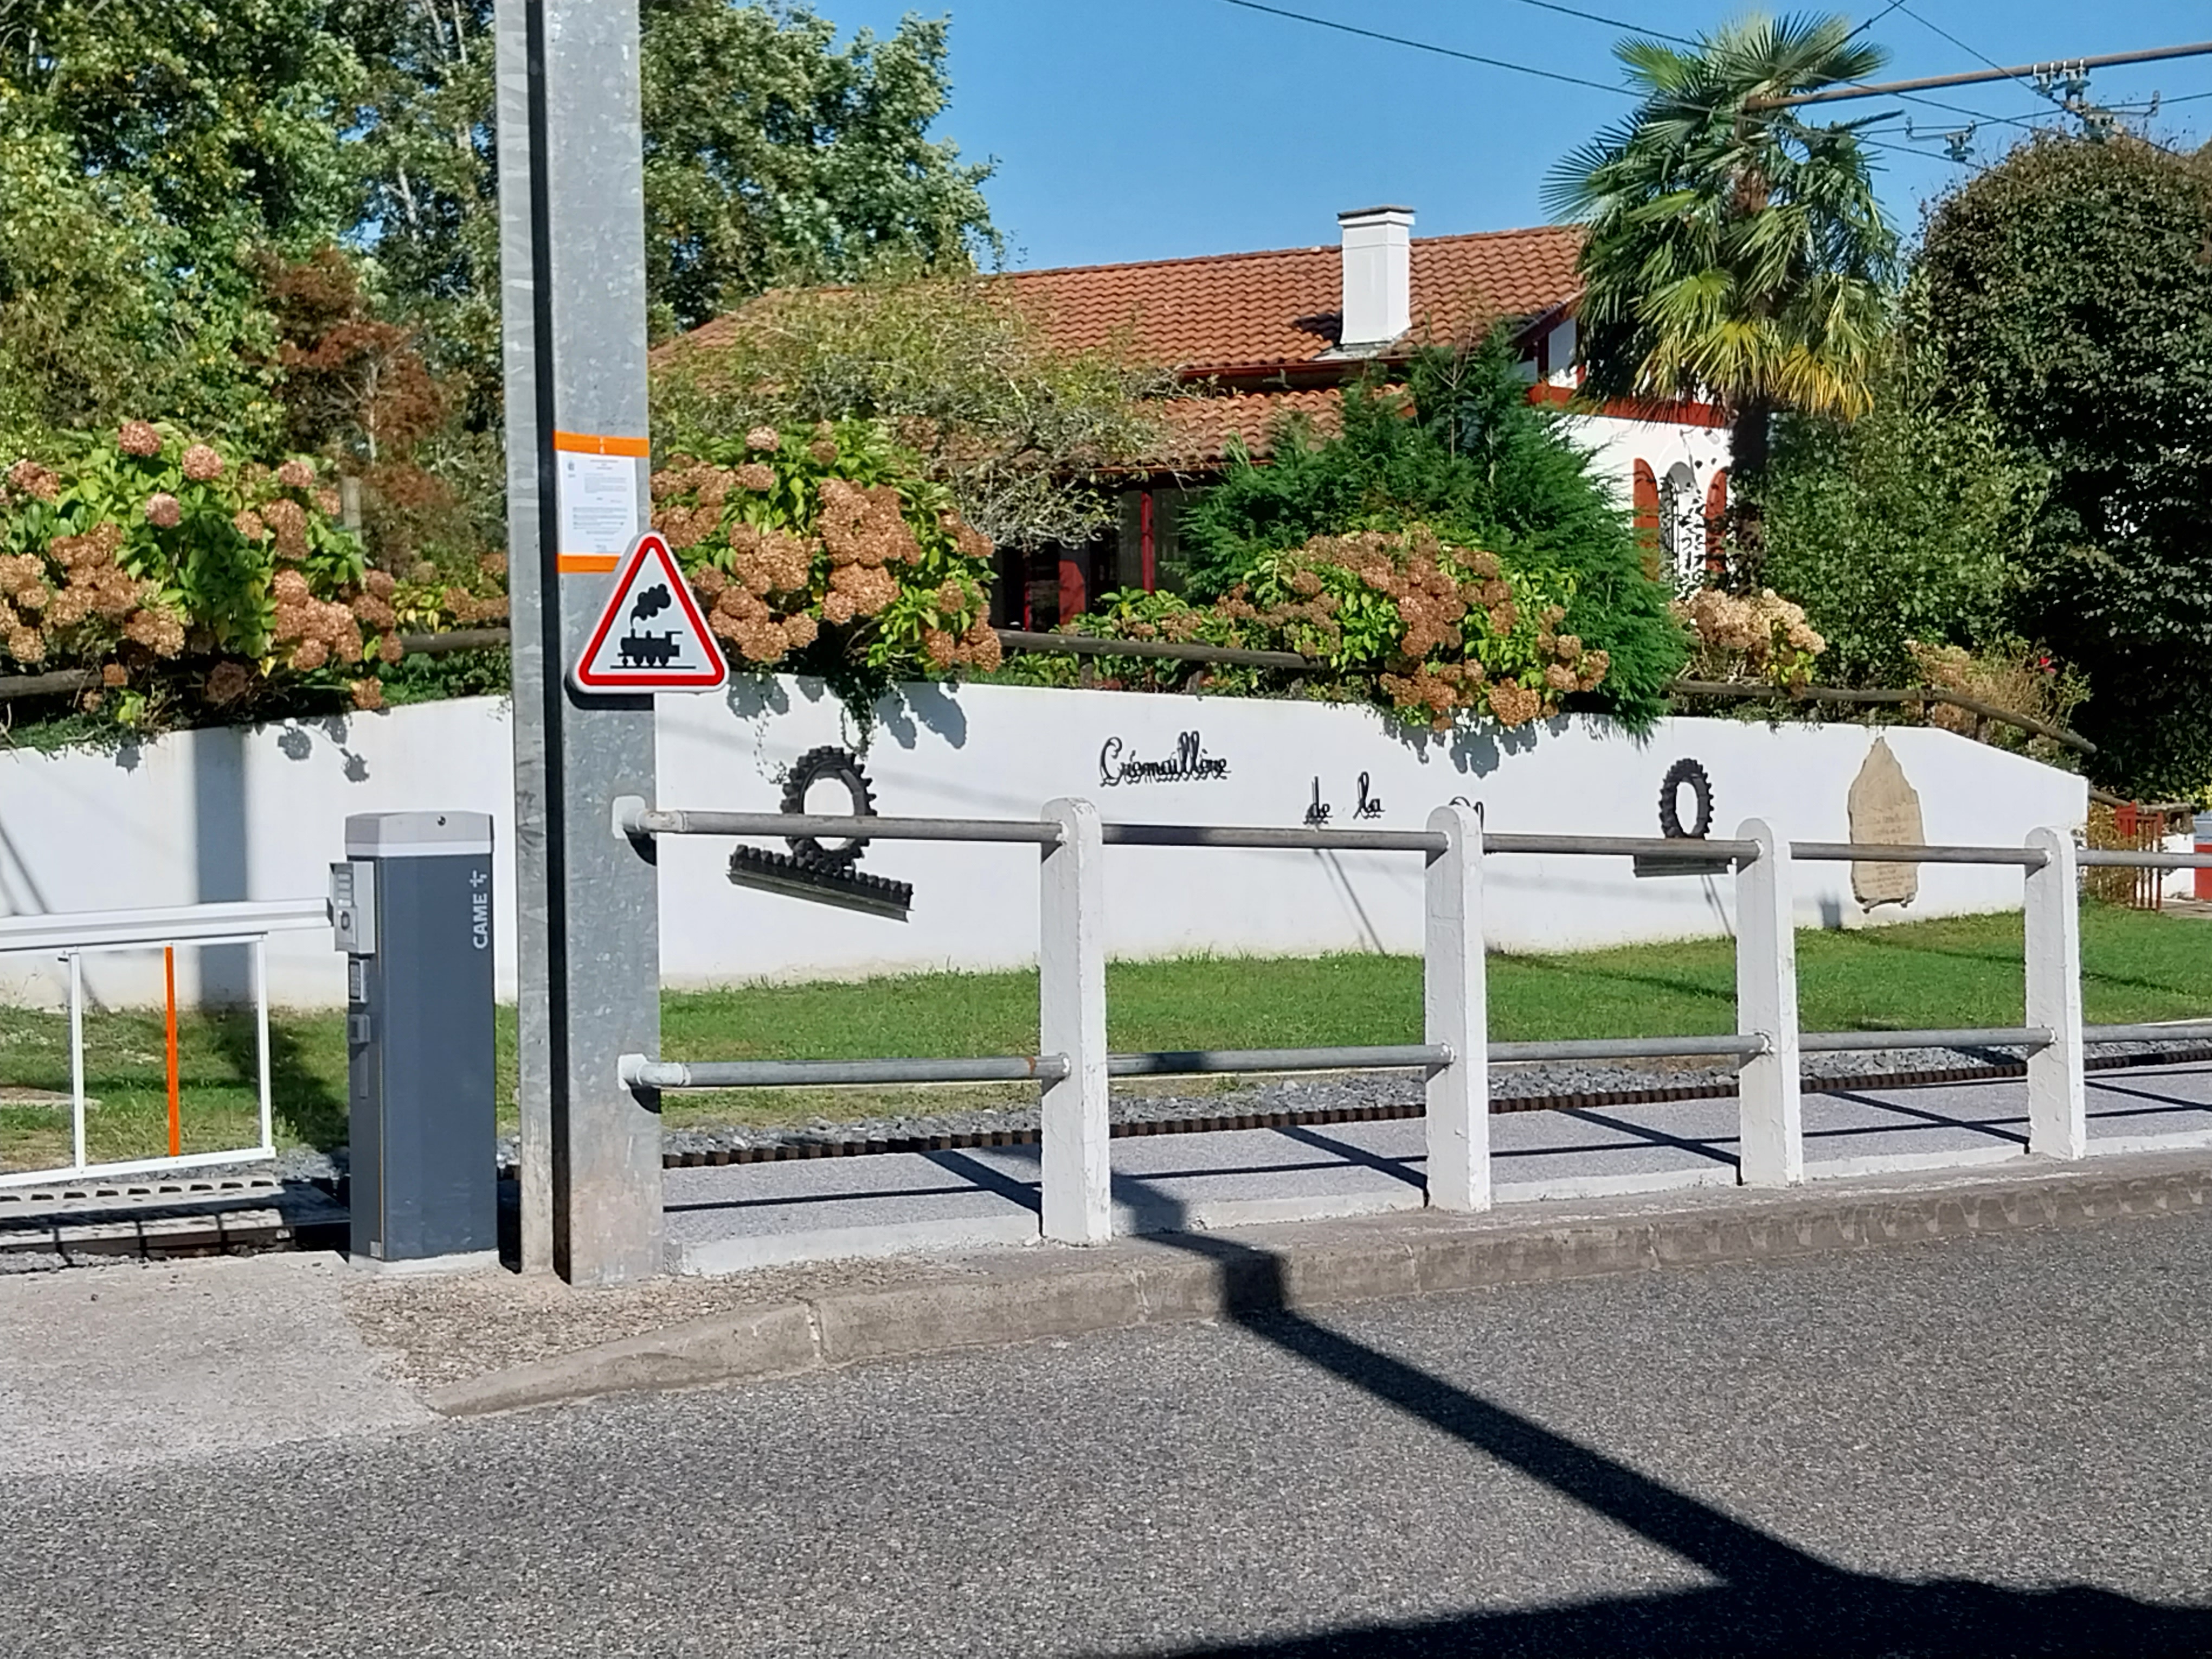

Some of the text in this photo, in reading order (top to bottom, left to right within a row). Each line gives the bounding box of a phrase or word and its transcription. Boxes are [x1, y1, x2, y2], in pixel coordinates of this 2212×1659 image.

[1303, 771, 1386, 824] de la
[473, 893, 488, 949] CAME
